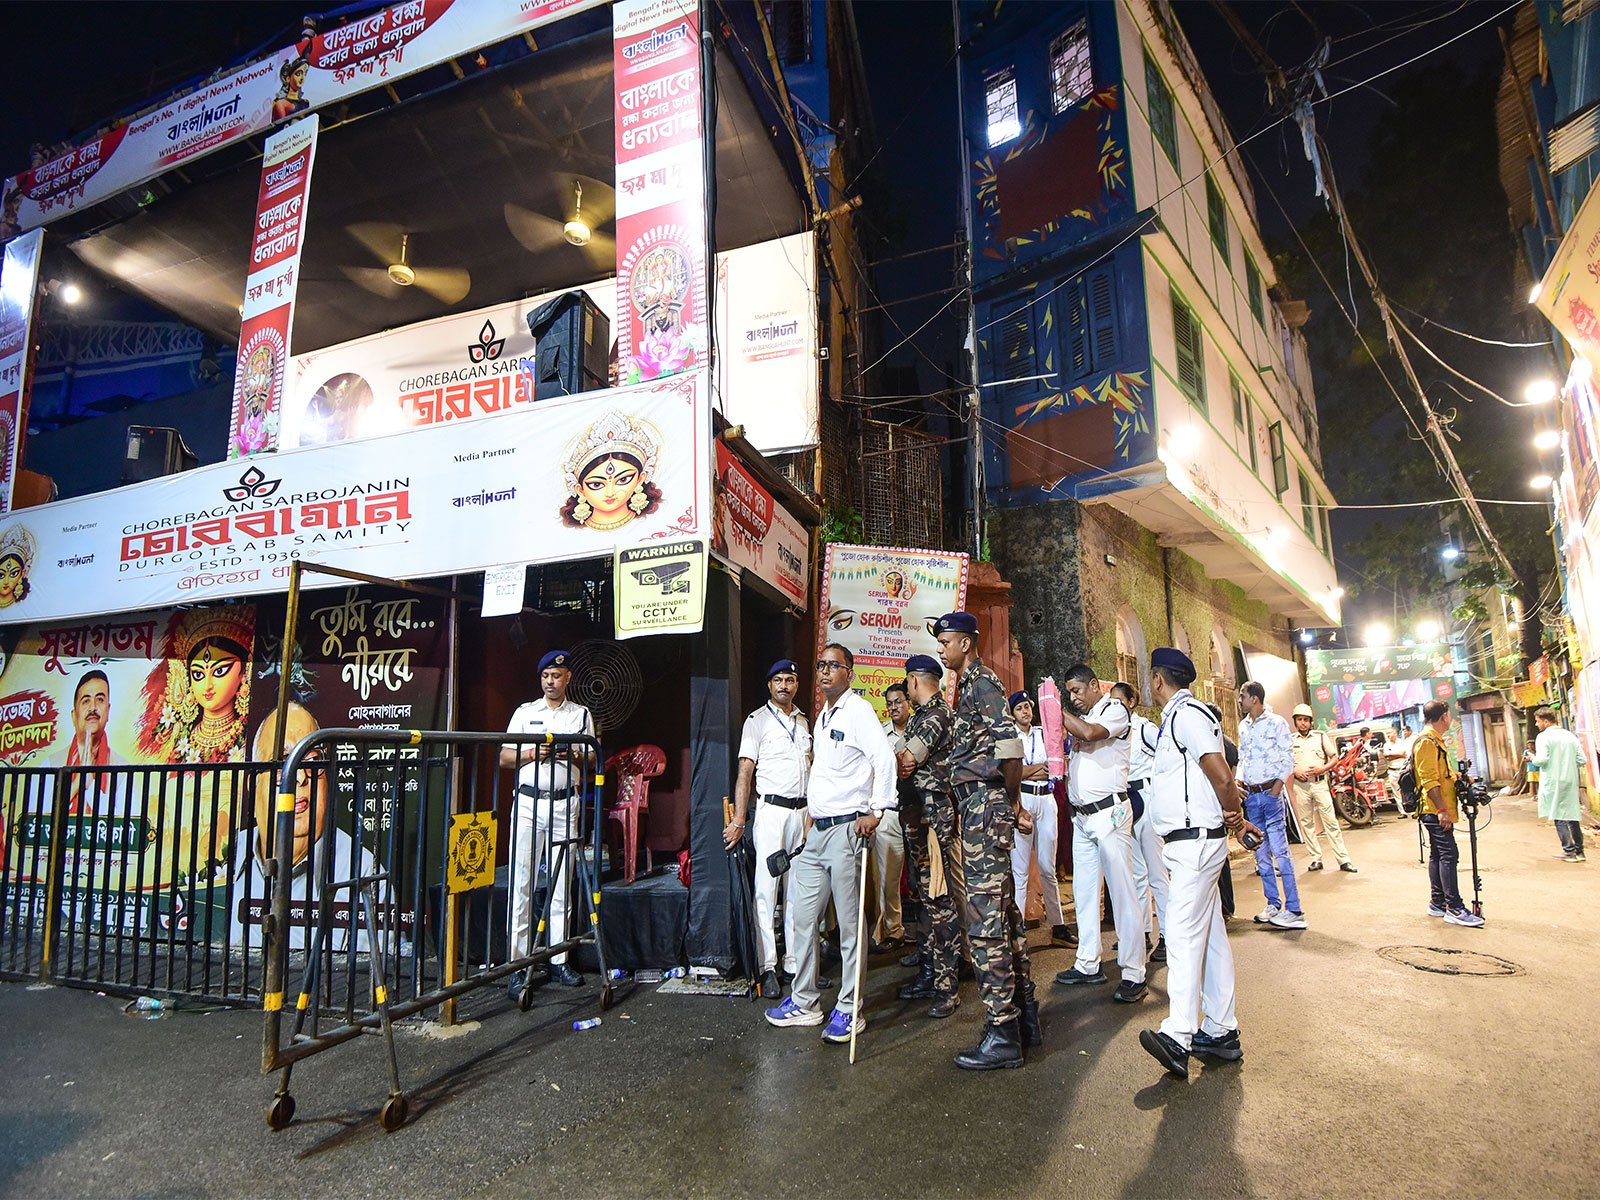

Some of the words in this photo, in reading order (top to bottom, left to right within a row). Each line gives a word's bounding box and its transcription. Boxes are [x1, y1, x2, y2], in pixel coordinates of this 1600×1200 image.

[614, 18, 638, 33] digital
[639, 13, 661, 24] News
[662, 0, 696, 15] Network
[628, 2, 660, 18] Bengal's
[323, 12, 387, 50] বাংলাকে
[392, 0, 426, 27] রক্ষা
[318, 46, 350, 68] করার
[353, 35, 379, 55] জন্য
[382, 17, 426, 44] ধন্যবাদ
[360, 55, 376, 74] মা
[128, 115, 160, 136] Bengal's
[161, 111, 175, 123] No.
[183, 91, 209, 111] digital
[209, 83, 234, 99] News
[235, 62, 274, 87] Network
[620, 67, 696, 110] বাংলাকে
[621, 111, 640, 127] রক্ষা
[641, 102, 670, 119] করার
[672, 93, 696, 109] জন্য
[158, 115, 246, 158] WWW.BANGLAHUNT.COM
[621, 108, 698, 150] ধন্যবাদ
[34, 151, 77, 184] বাংলাকে
[650, 167, 667, 185] মা
[258, 193, 303, 230] বাংলাকে
[254, 229, 298, 263] ধন্যবাদ
[399, 364, 488, 393] CHOREBAGAN
[453, 452, 480, 463] Media
[482, 446, 517, 460] Partner
[122, 500, 256, 536] CHOREBAGAN
[261, 477, 410, 509] SARBOJANIN
[78, 522, 98, 531] Partner
[119, 539, 277, 573] DURGOTSAB
[294, 521, 412, 546] SAMITY
[628, 543, 694, 560] WARNING
[200, 556, 243, 571] ESTD
[260, 549, 301, 564] 1936
[495, 584, 517, 596] EXIT
[868, 590, 888, 598] SERUM
[310, 586, 372, 658] তুমি
[632, 615, 688, 626] SURVEILLANCE
[643, 607, 677, 618] CCTV
[860, 612, 902, 629] SERUM
[903, 623, 922, 632] Group
[877, 627, 903, 636] Presents
[884, 636, 911, 645] Biggest
[37, 621, 158, 676] সুস্বাগতম
[858, 648, 885, 656] Sharod
[872, 643, 897, 651] Crown
[341, 636, 418, 701] নীরবে
[38, 701, 47, 715] ও
[348, 704, 412, 721] মোহনবাগানের
[0, 722, 54, 752] ভিনন্দন
